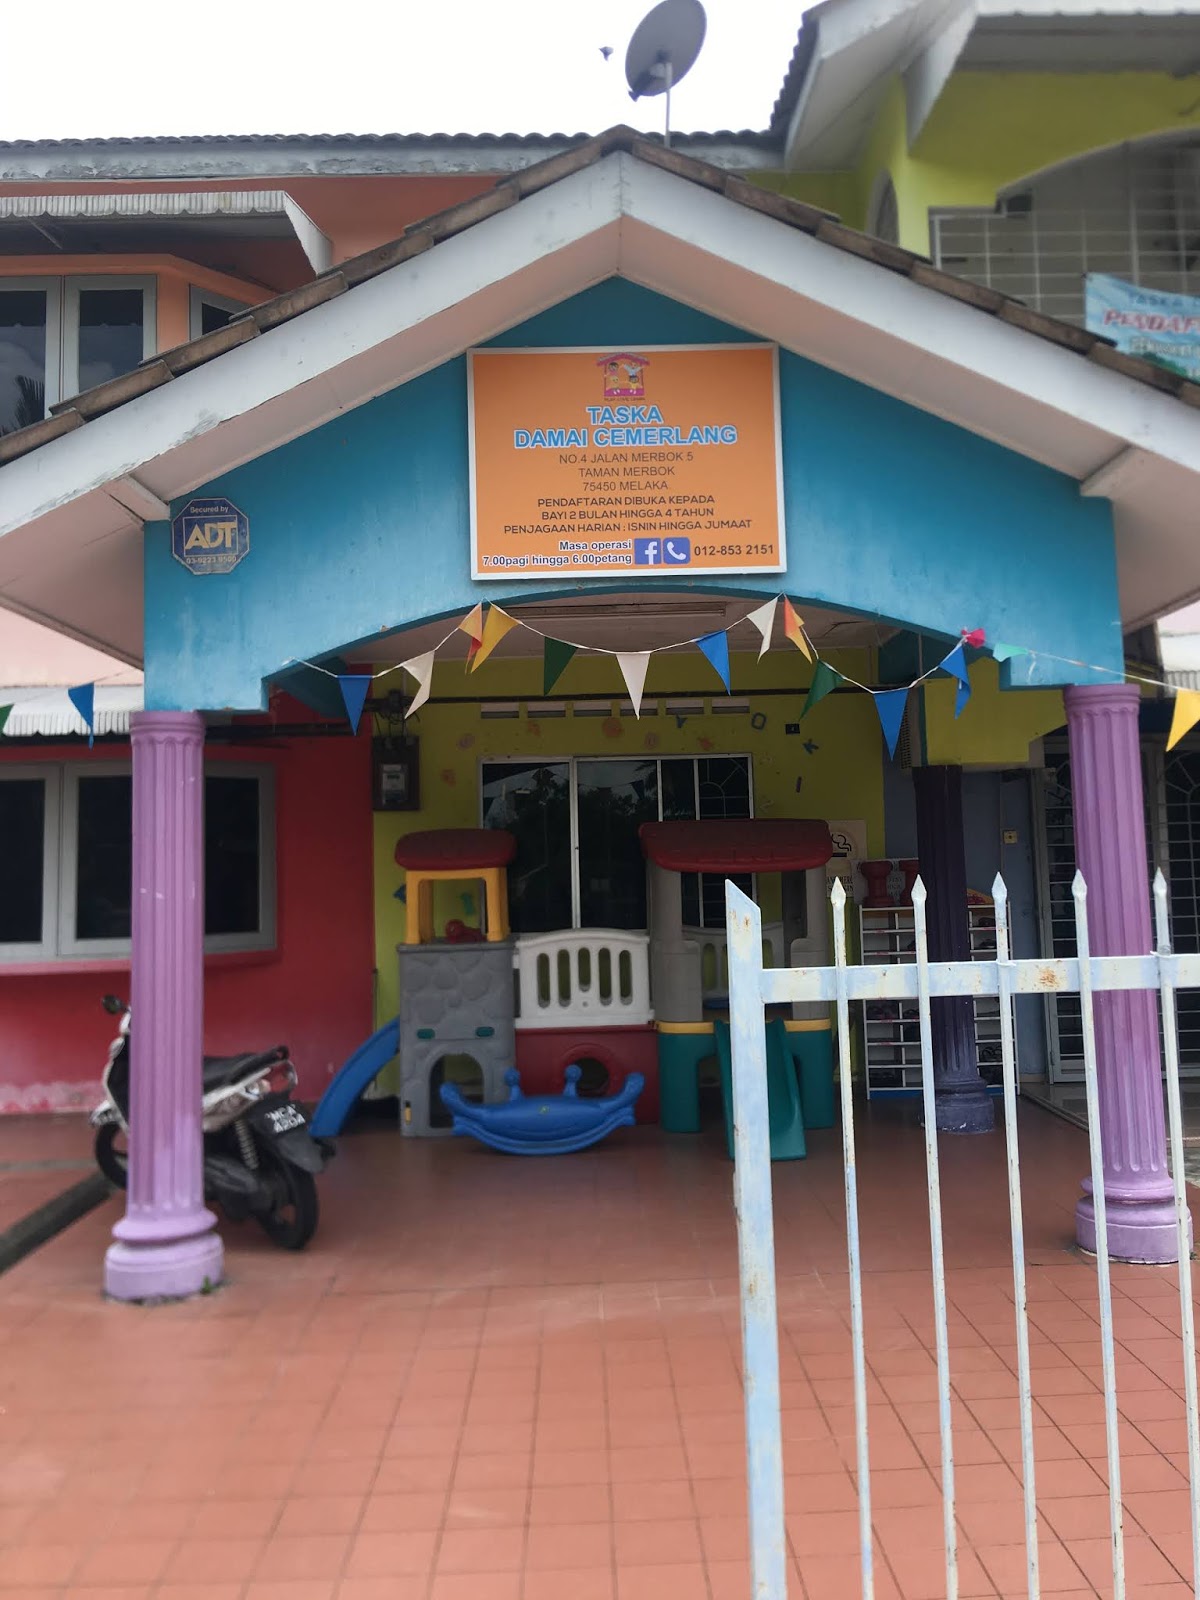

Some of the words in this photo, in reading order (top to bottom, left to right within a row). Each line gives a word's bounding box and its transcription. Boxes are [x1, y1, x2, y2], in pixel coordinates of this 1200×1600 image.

[586, 405, 663, 426] TASKA
[514, 428, 588, 449] DAMAI
[593, 425, 738, 447] CEMERLANG
[559, 453, 587, 464] NO.4
[591, 452, 628, 463] JALAN
[631, 451, 684, 463] MERBOK
[686, 451, 694, 462] 5
[578, 467, 620, 478] TAMAN
[623, 466, 676, 477] MERBOK
[583, 481, 616, 491] 75450
[619, 480, 669, 491] MELAKA
[537, 497, 622, 508] PENDAFTARAN
[624, 496, 667, 506] DIBUKA
[668, 495, 715, 505] KEPADA
[190, 506, 219, 514] Secured
[220, 505, 229, 513] by
[541, 511, 567, 521] BAYI
[569, 511, 577, 520] 2
[578, 510, 617, 520] BULAN
[619, 509, 663, 519] HINGGA
[665, 508, 673, 518] 4
[675, 508, 714, 517] TAHUN
[504, 524, 576, 534] PENJAGAAN
[577, 523, 621, 533] HARIAN
[627, 521, 657, 532] ISNIN
[658, 520, 702, 531] HINGGA
[704, 519, 752, 530] JUMAAT
[184, 521, 237, 550] ADT
[559, 540, 588, 551] Masa
[590, 539, 632, 552] operasi
[694, 544, 742, 556] 012-853
[745, 544, 774, 555] 2151
[482, 555, 529, 567] 7.00pagi
[531, 555, 570, 568] hingga
[572, 553, 632, 565] 6.00petang
